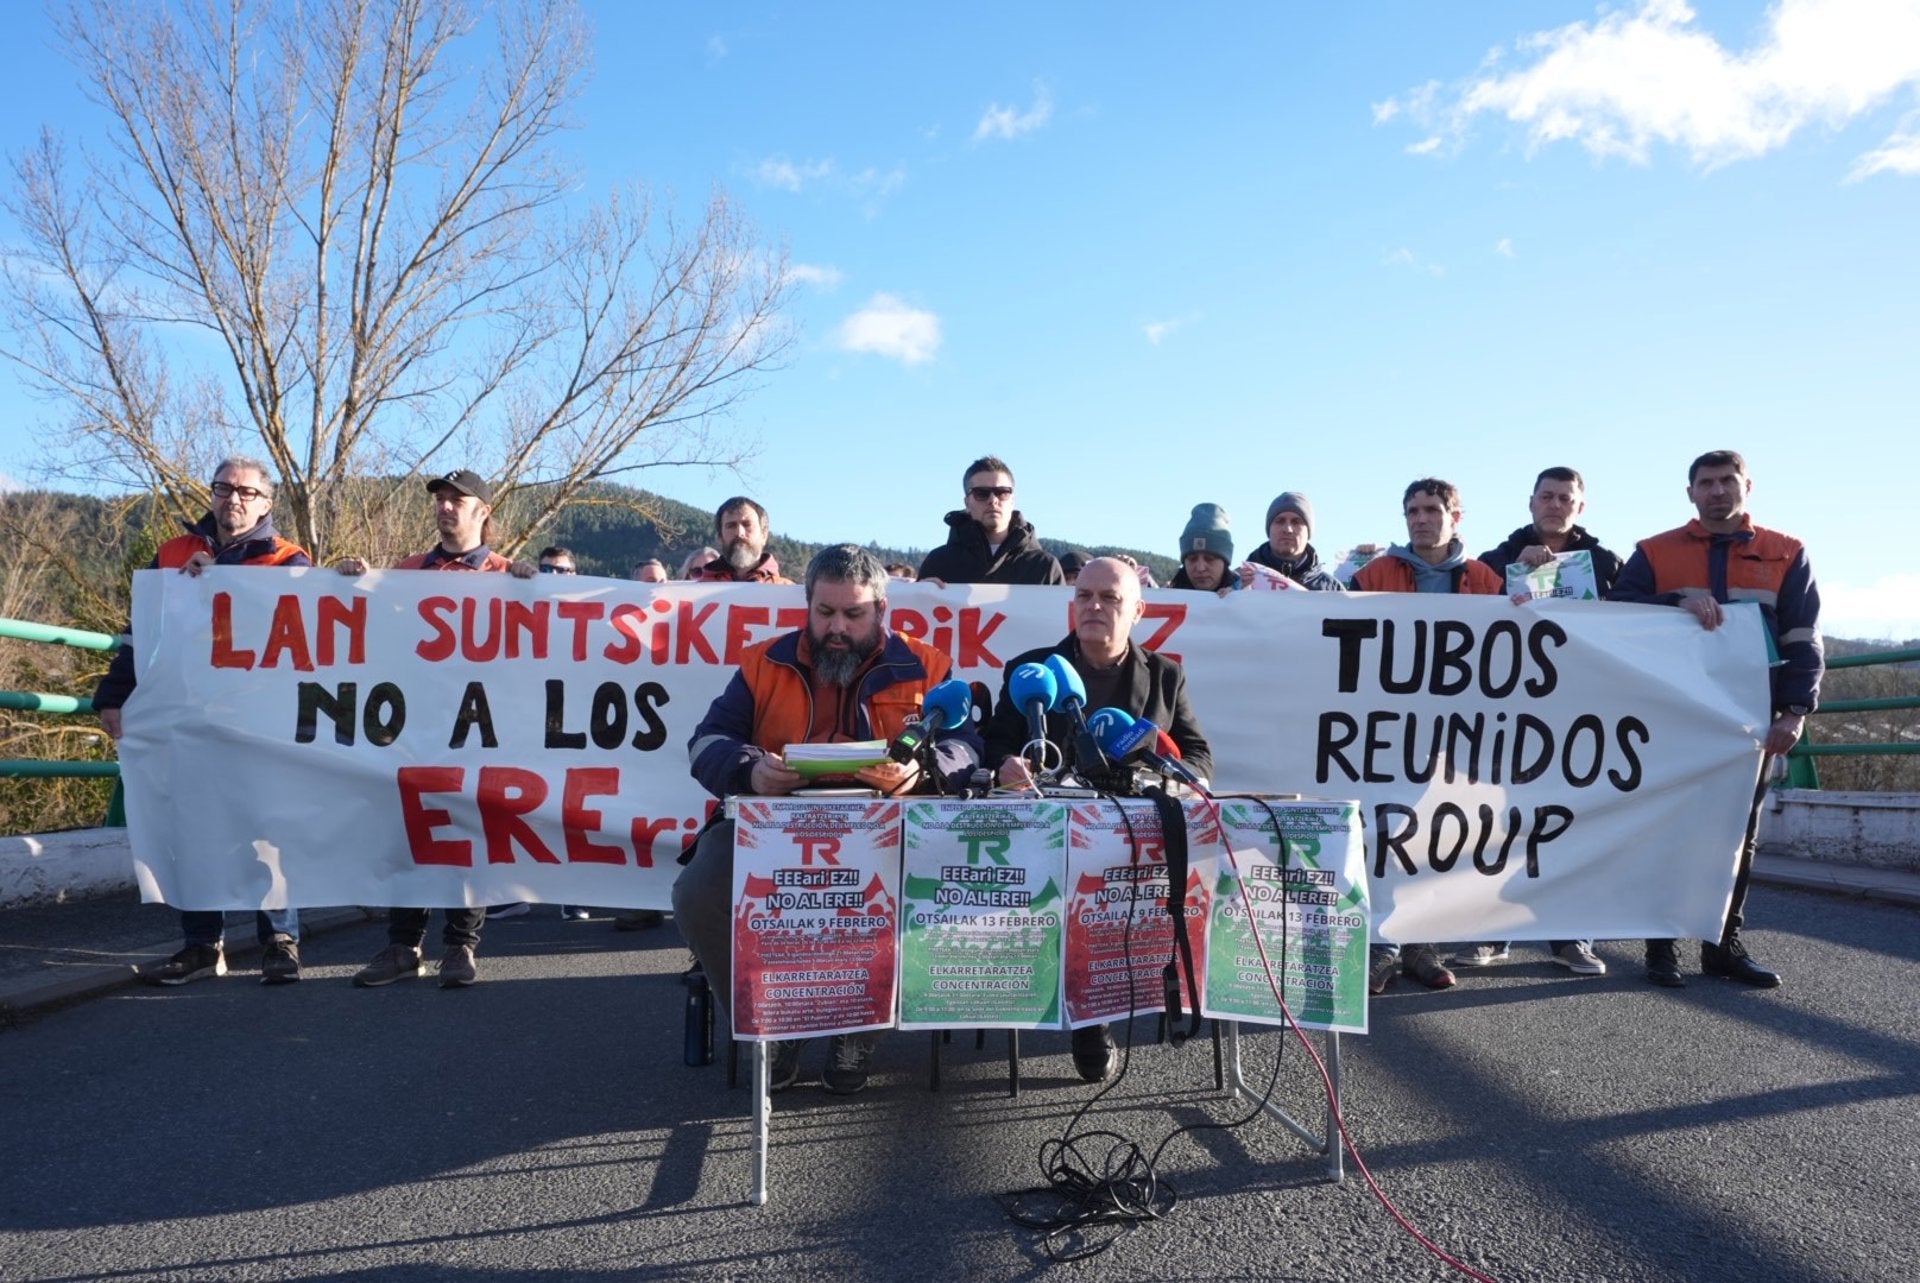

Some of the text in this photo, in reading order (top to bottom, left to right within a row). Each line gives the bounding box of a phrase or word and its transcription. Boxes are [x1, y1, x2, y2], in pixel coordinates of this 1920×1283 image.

[211, 592, 367, 671] LAN
[415, 595, 1007, 669] SUNTSiKERiK
[1322, 618, 1567, 698] TUBOS
[295, 679, 671, 751] NO A LOS
[1359, 801, 1575, 878] ROUP
[793, 837, 841, 865] TR
[958, 836, 1010, 865] TR
[1269, 837, 1321, 868] TR
[774, 869, 860, 886] EEEari EZ!!
[942, 868, 1025, 884] EEEari EZ!!
[1151, 865, 1169, 878] EZ
[1306, 871, 1335, 886] EZ!!
[766, 892, 865, 910] NO AL ERE!!
[935, 889, 1030, 907] NO AL ERE!!
[1095, 885, 1171, 904] NO AL ERE
[1246, 886, 1338, 906] NO AL ERE!!
[916, 913, 1055, 927] OTSAILAK 13 FEBRERO
[1138, 908, 1145, 918] 9
[1148, 906, 1199, 918] FEBRO
[1288, 911, 1302, 922] 13
[1306, 913, 1360, 927] FEBRERO
[750, 916, 886, 930] OTSAILAK 9 FEBRERO
[930, 965, 1033, 976] ELKARRETARATZEA
[1088, 952, 1180, 972] ELKARRTARATZEA
[762, 970, 869, 983] ELKARRETARATZEA
[933, 978, 1029, 990] CONCENTRACIÓN
[1091, 967, 1165, 986] CONCENTRACI
[765, 983, 865, 998] CONCENTRACIÓN
